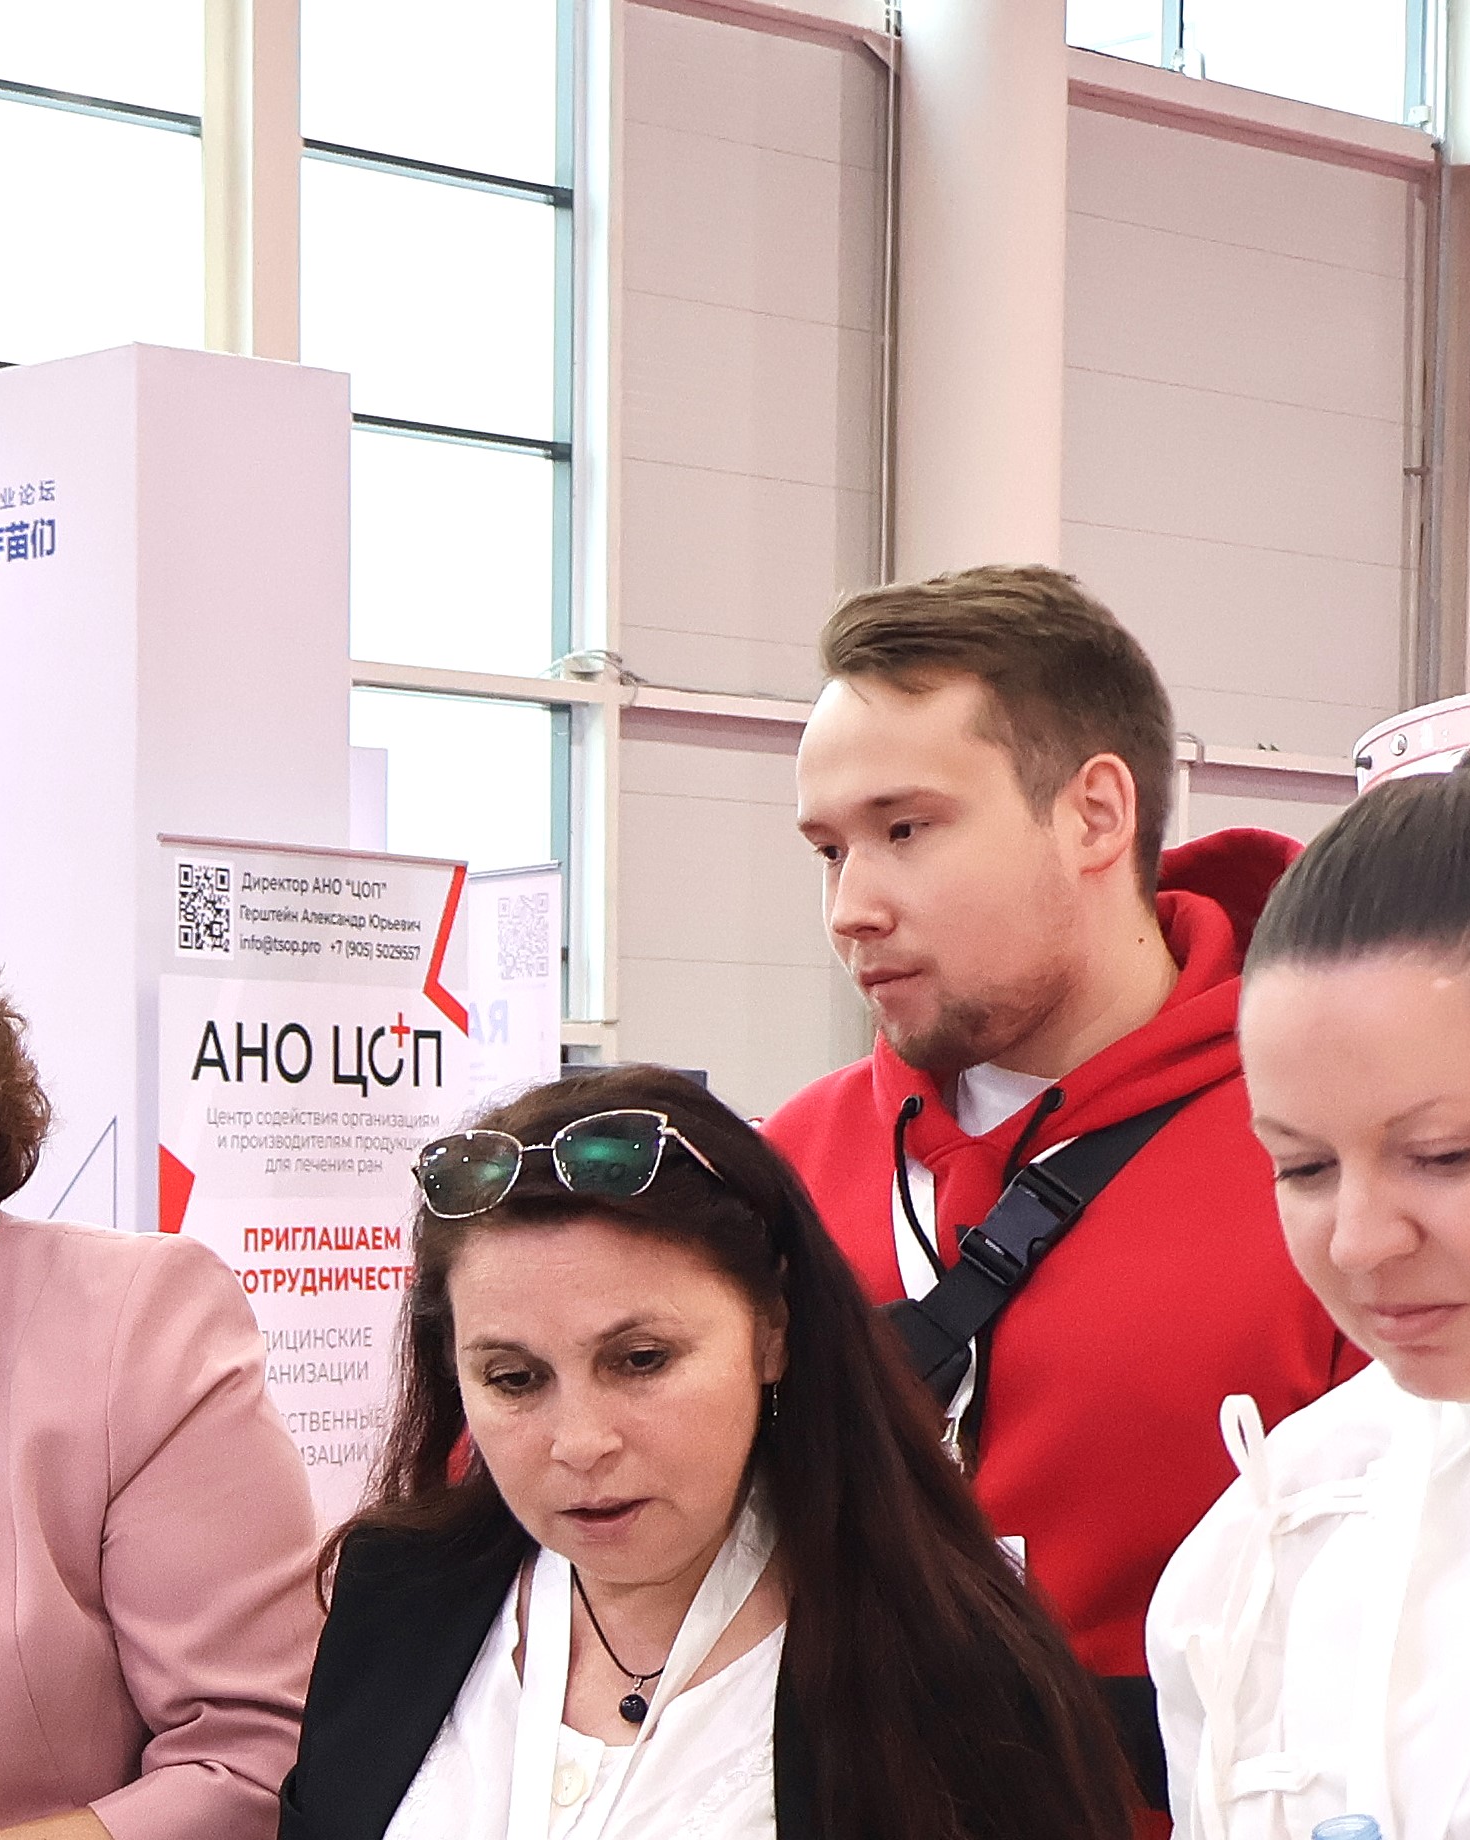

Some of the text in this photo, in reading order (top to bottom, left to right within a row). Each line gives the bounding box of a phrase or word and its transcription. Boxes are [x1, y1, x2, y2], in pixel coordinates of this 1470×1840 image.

[241, 872, 309, 896] Директор
[312, 877, 342, 895] АНО
[239, 904, 421, 932] Герштейн Александр Юрьевич
[191, 1020, 313, 1085] АНО
[207, 1108, 440, 1131] Центр содействия организациям
[230, 1134, 351, 1151] производителям
[265, 1157, 383, 1176] для лечения ран
[243, 1227, 401, 1253] ПРИГЛАШАЕМ
